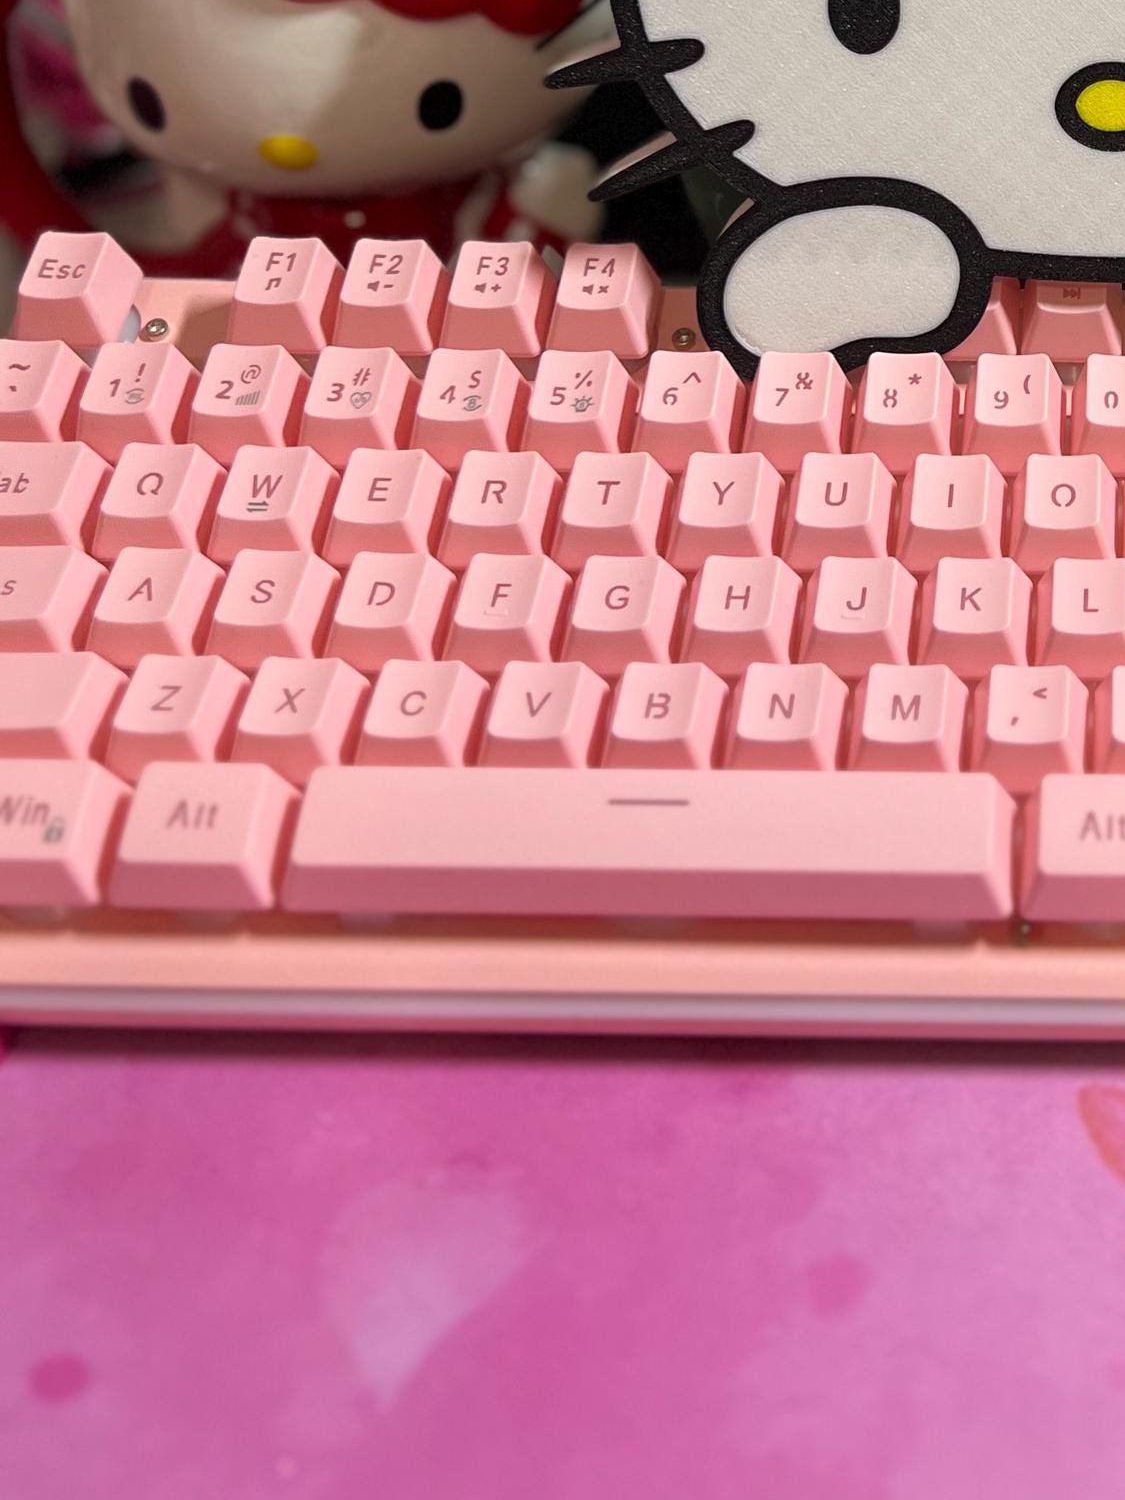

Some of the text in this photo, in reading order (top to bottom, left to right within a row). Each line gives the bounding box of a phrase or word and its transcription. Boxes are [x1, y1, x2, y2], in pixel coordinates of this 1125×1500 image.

[38, 259, 85, 279] Esc
[266, 252, 296, 272] F1
[369, 254, 403, 274] F2
[477, 256, 509, 276] F3
[584, 258, 615, 277] F4
[110, 363, 146, 397] 1 !
[215, 365, 261, 399] 2 @
[327, 368, 371, 401] 3 #
[550, 370, 592, 405] 5 %
[663, 372, 701, 405] 6 ^
[776, 372, 813, 406] 7 &
[440, 385, 456, 403] 4
[883, 389, 897, 408] 8
[994, 391, 1009, 409] 9
[1104, 391, 1118, 408] 0
[0, 473, 29, 493] ab
[137, 473, 163, 495] Q
[252, 475, 283, 498] W
[368, 478, 392, 501] E
[481, 480, 507, 504] R
[597, 481, 620, 505] T
[713, 482, 734, 505] Y
[825, 482, 848, 506] U
[1051, 484, 1076, 507] O
[128, 578, 152, 601] A
[251, 580, 275, 603] S
[368, 582, 395, 606] D
[491, 583, 512, 607] F
[605, 586, 630, 610] G
[725, 585, 750, 610] H
[846, 587, 867, 611] J
[960, 588, 981, 611] K
[1083, 588, 1098, 612] L
[151, 686, 182, 711] Z
[275, 688, 305, 713] X
[400, 691, 426, 716] C
[526, 692, 552, 717] V
[1033, 688, 1047, 699] <
[644, 693, 671, 719] B
[769, 693, 795, 719] N
[891, 695, 921, 720] M
[166, 799, 218, 828] Alt
